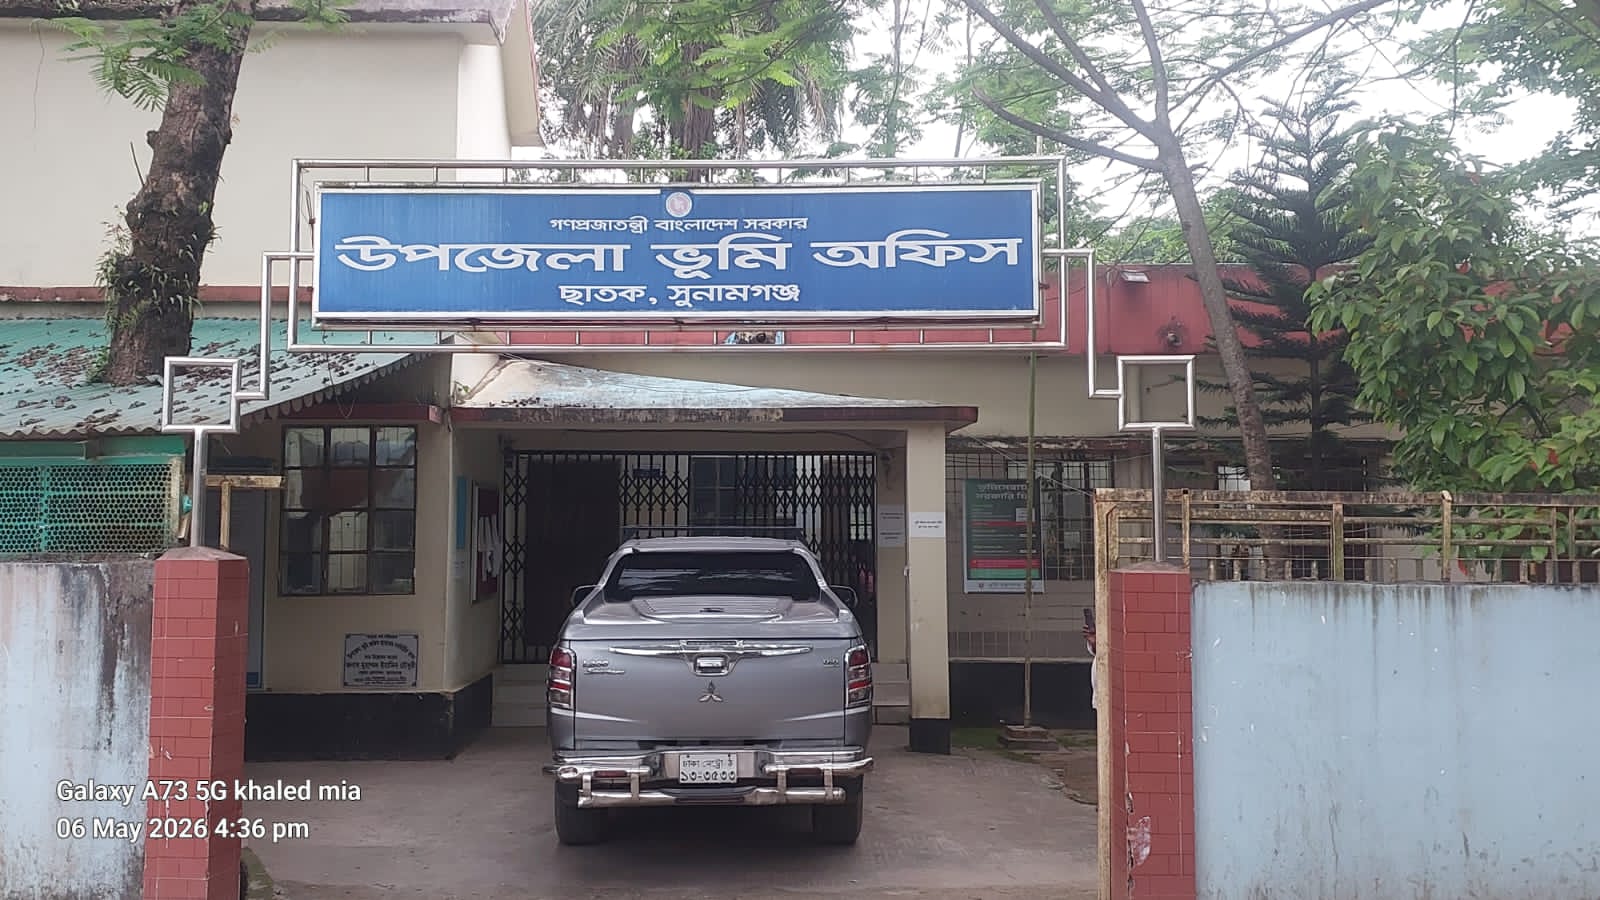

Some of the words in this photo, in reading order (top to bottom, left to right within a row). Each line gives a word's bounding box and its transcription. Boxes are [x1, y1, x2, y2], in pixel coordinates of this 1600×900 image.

[549, 216, 650, 234] গণপ্রজাতন্ত্রী
[654, 217, 739, 233] বাংলাদেশ
[743, 216, 809, 231] সরকার
[334, 235, 632, 273] উপজেলা
[651, 232, 793, 280] ভূমি
[810, 229, 1023, 269] অফিস
[558, 284, 657, 306] ছাতক,
[666, 284, 801, 308] সুনামগঞ্জ
